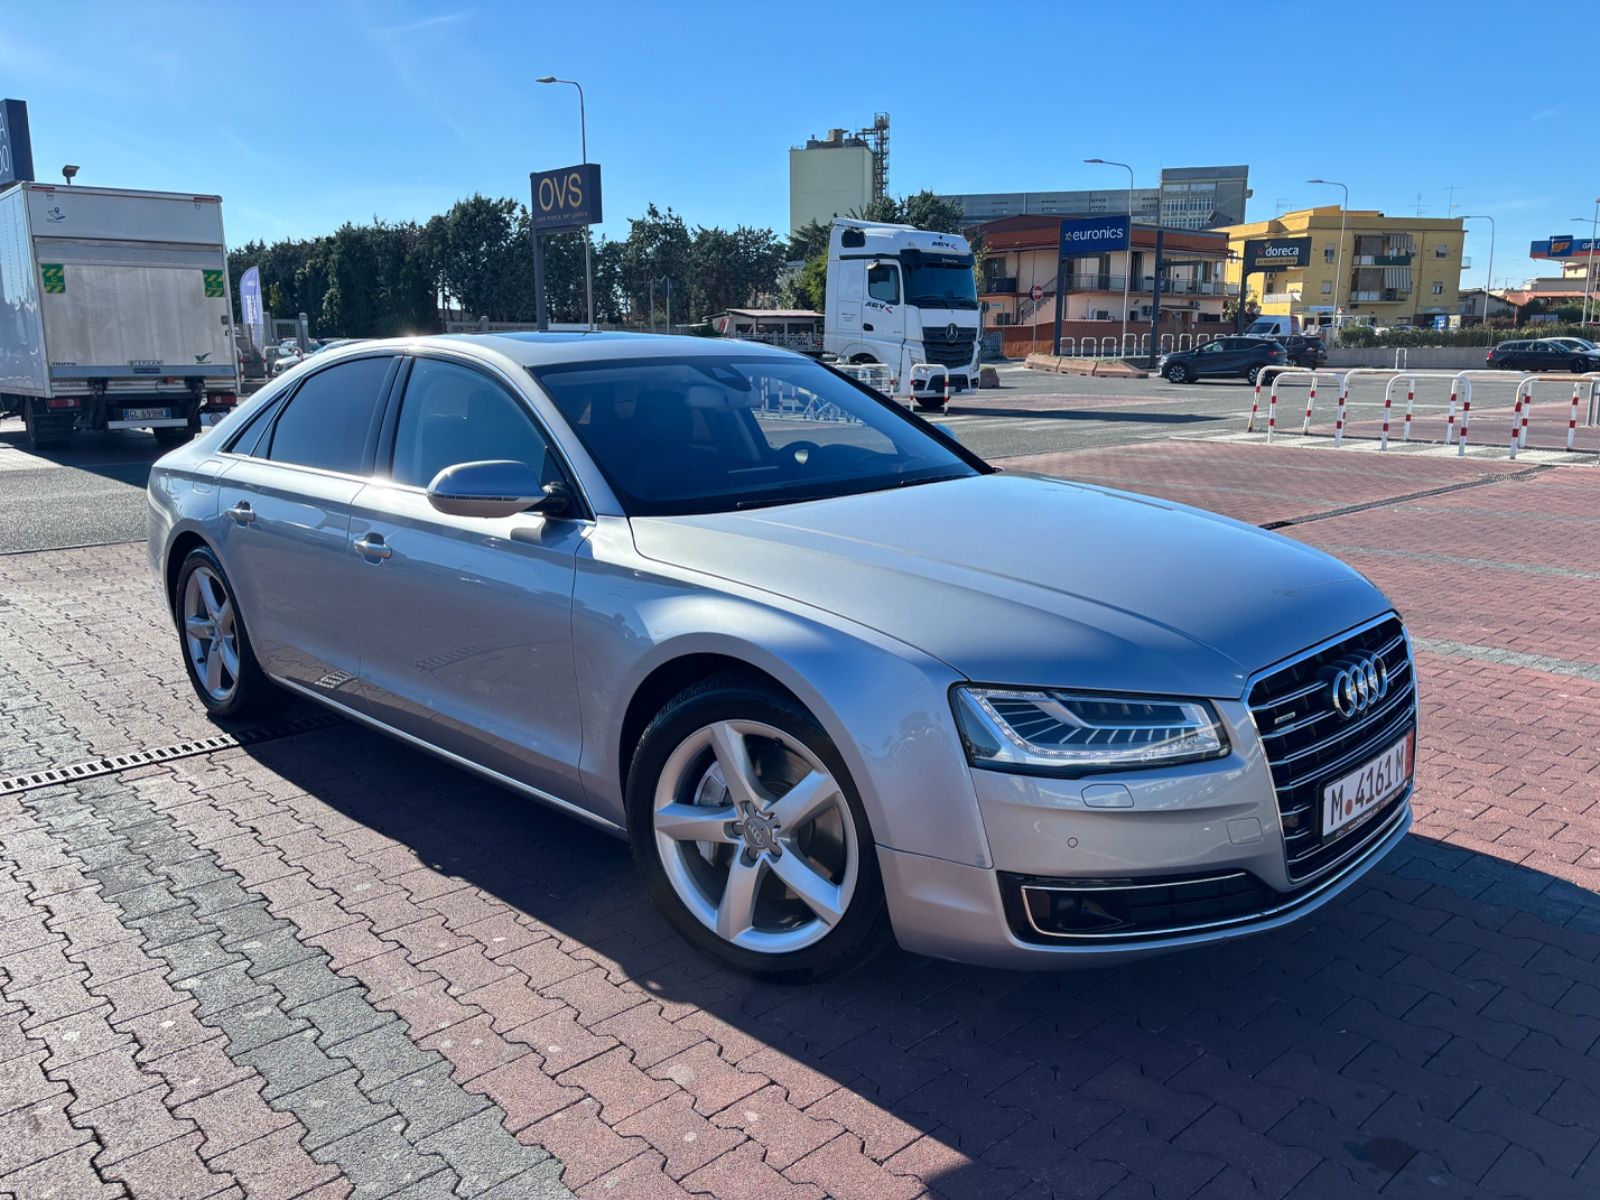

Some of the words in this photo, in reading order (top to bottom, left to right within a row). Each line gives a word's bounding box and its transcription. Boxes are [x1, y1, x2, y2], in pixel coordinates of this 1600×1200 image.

[539, 173, 583, 212] OVS
[1072, 226, 1124, 241] euronics
[1265, 246, 1300, 256] doreca
[1331, 784, 1344, 826] M
[1355, 754, 1392, 808] 4161
